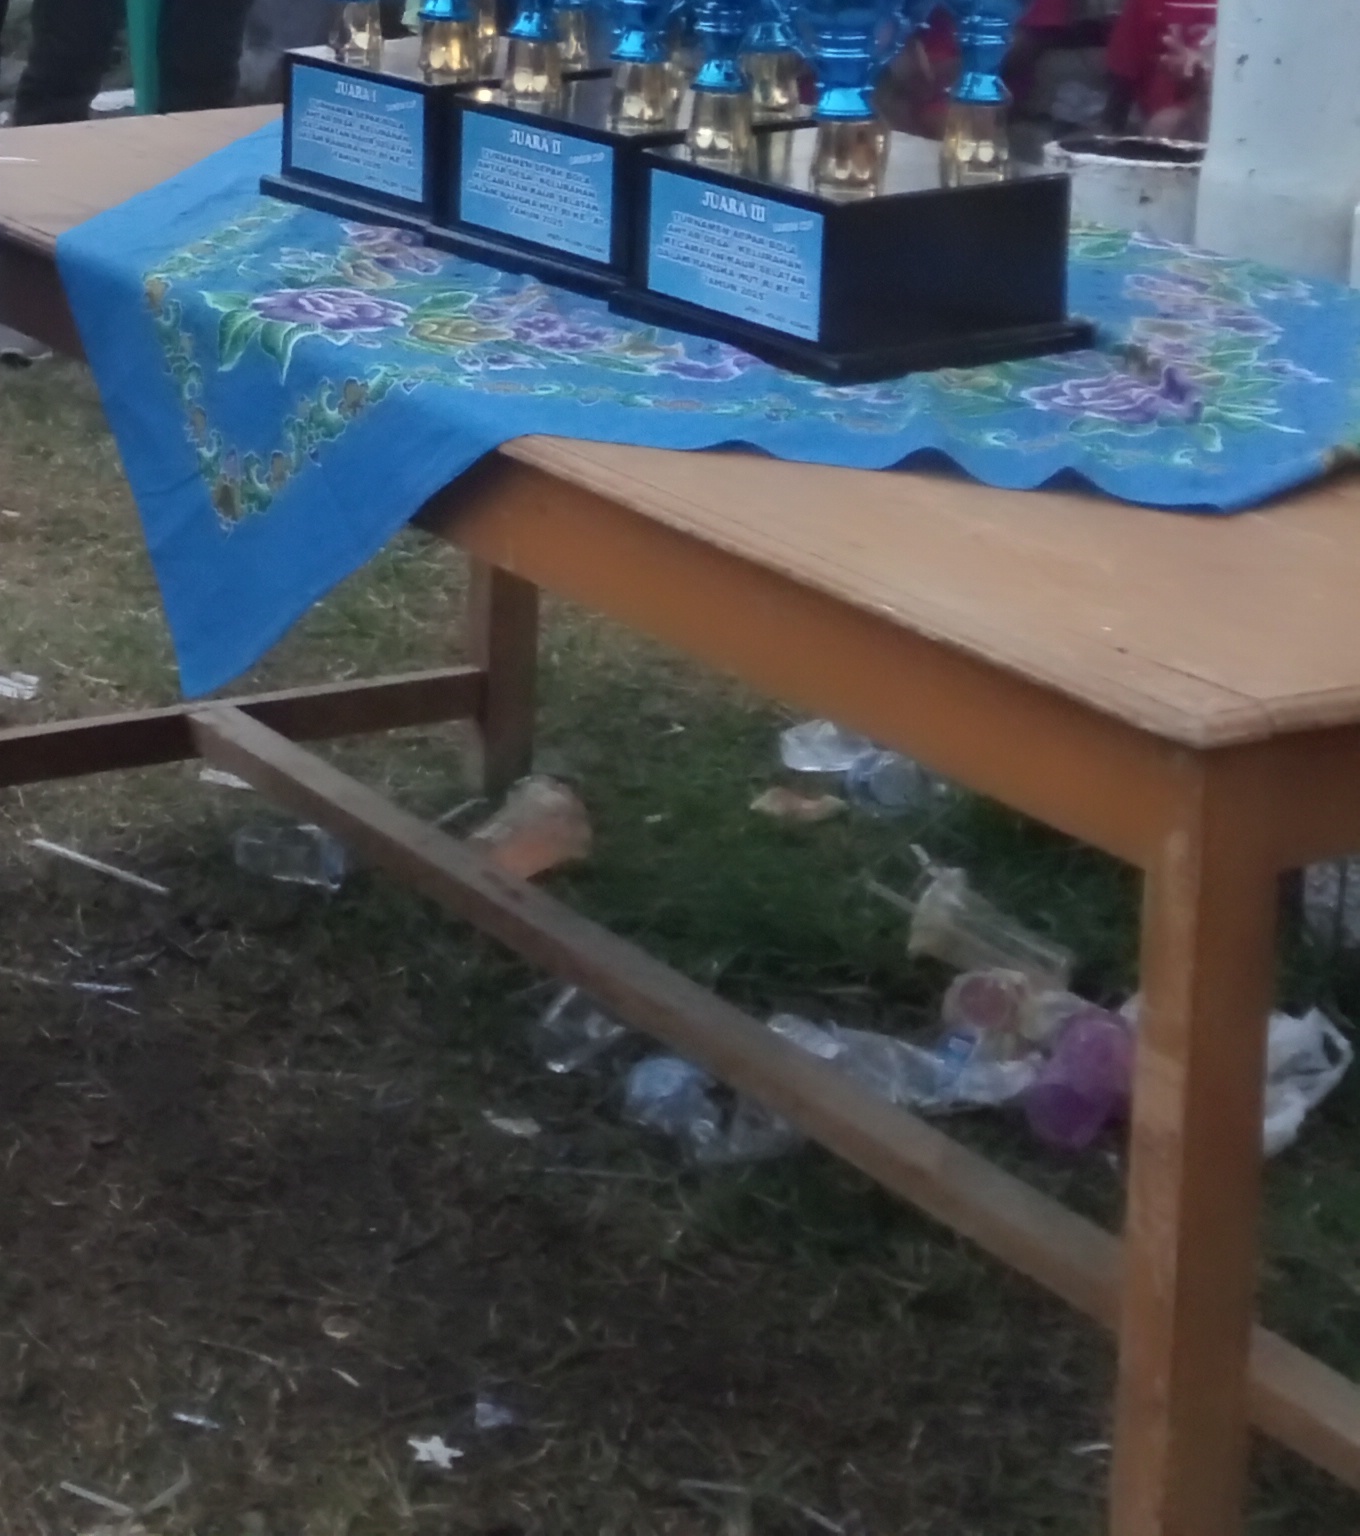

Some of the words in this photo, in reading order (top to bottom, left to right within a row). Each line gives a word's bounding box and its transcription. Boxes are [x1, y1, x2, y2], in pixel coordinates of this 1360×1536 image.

[335, 80, 370, 101] JUARA
[509, 128, 549, 153] JUARA
[552, 139, 561, 155] II
[702, 190, 748, 219] JUARA
[750, 203, 766, 223] III
